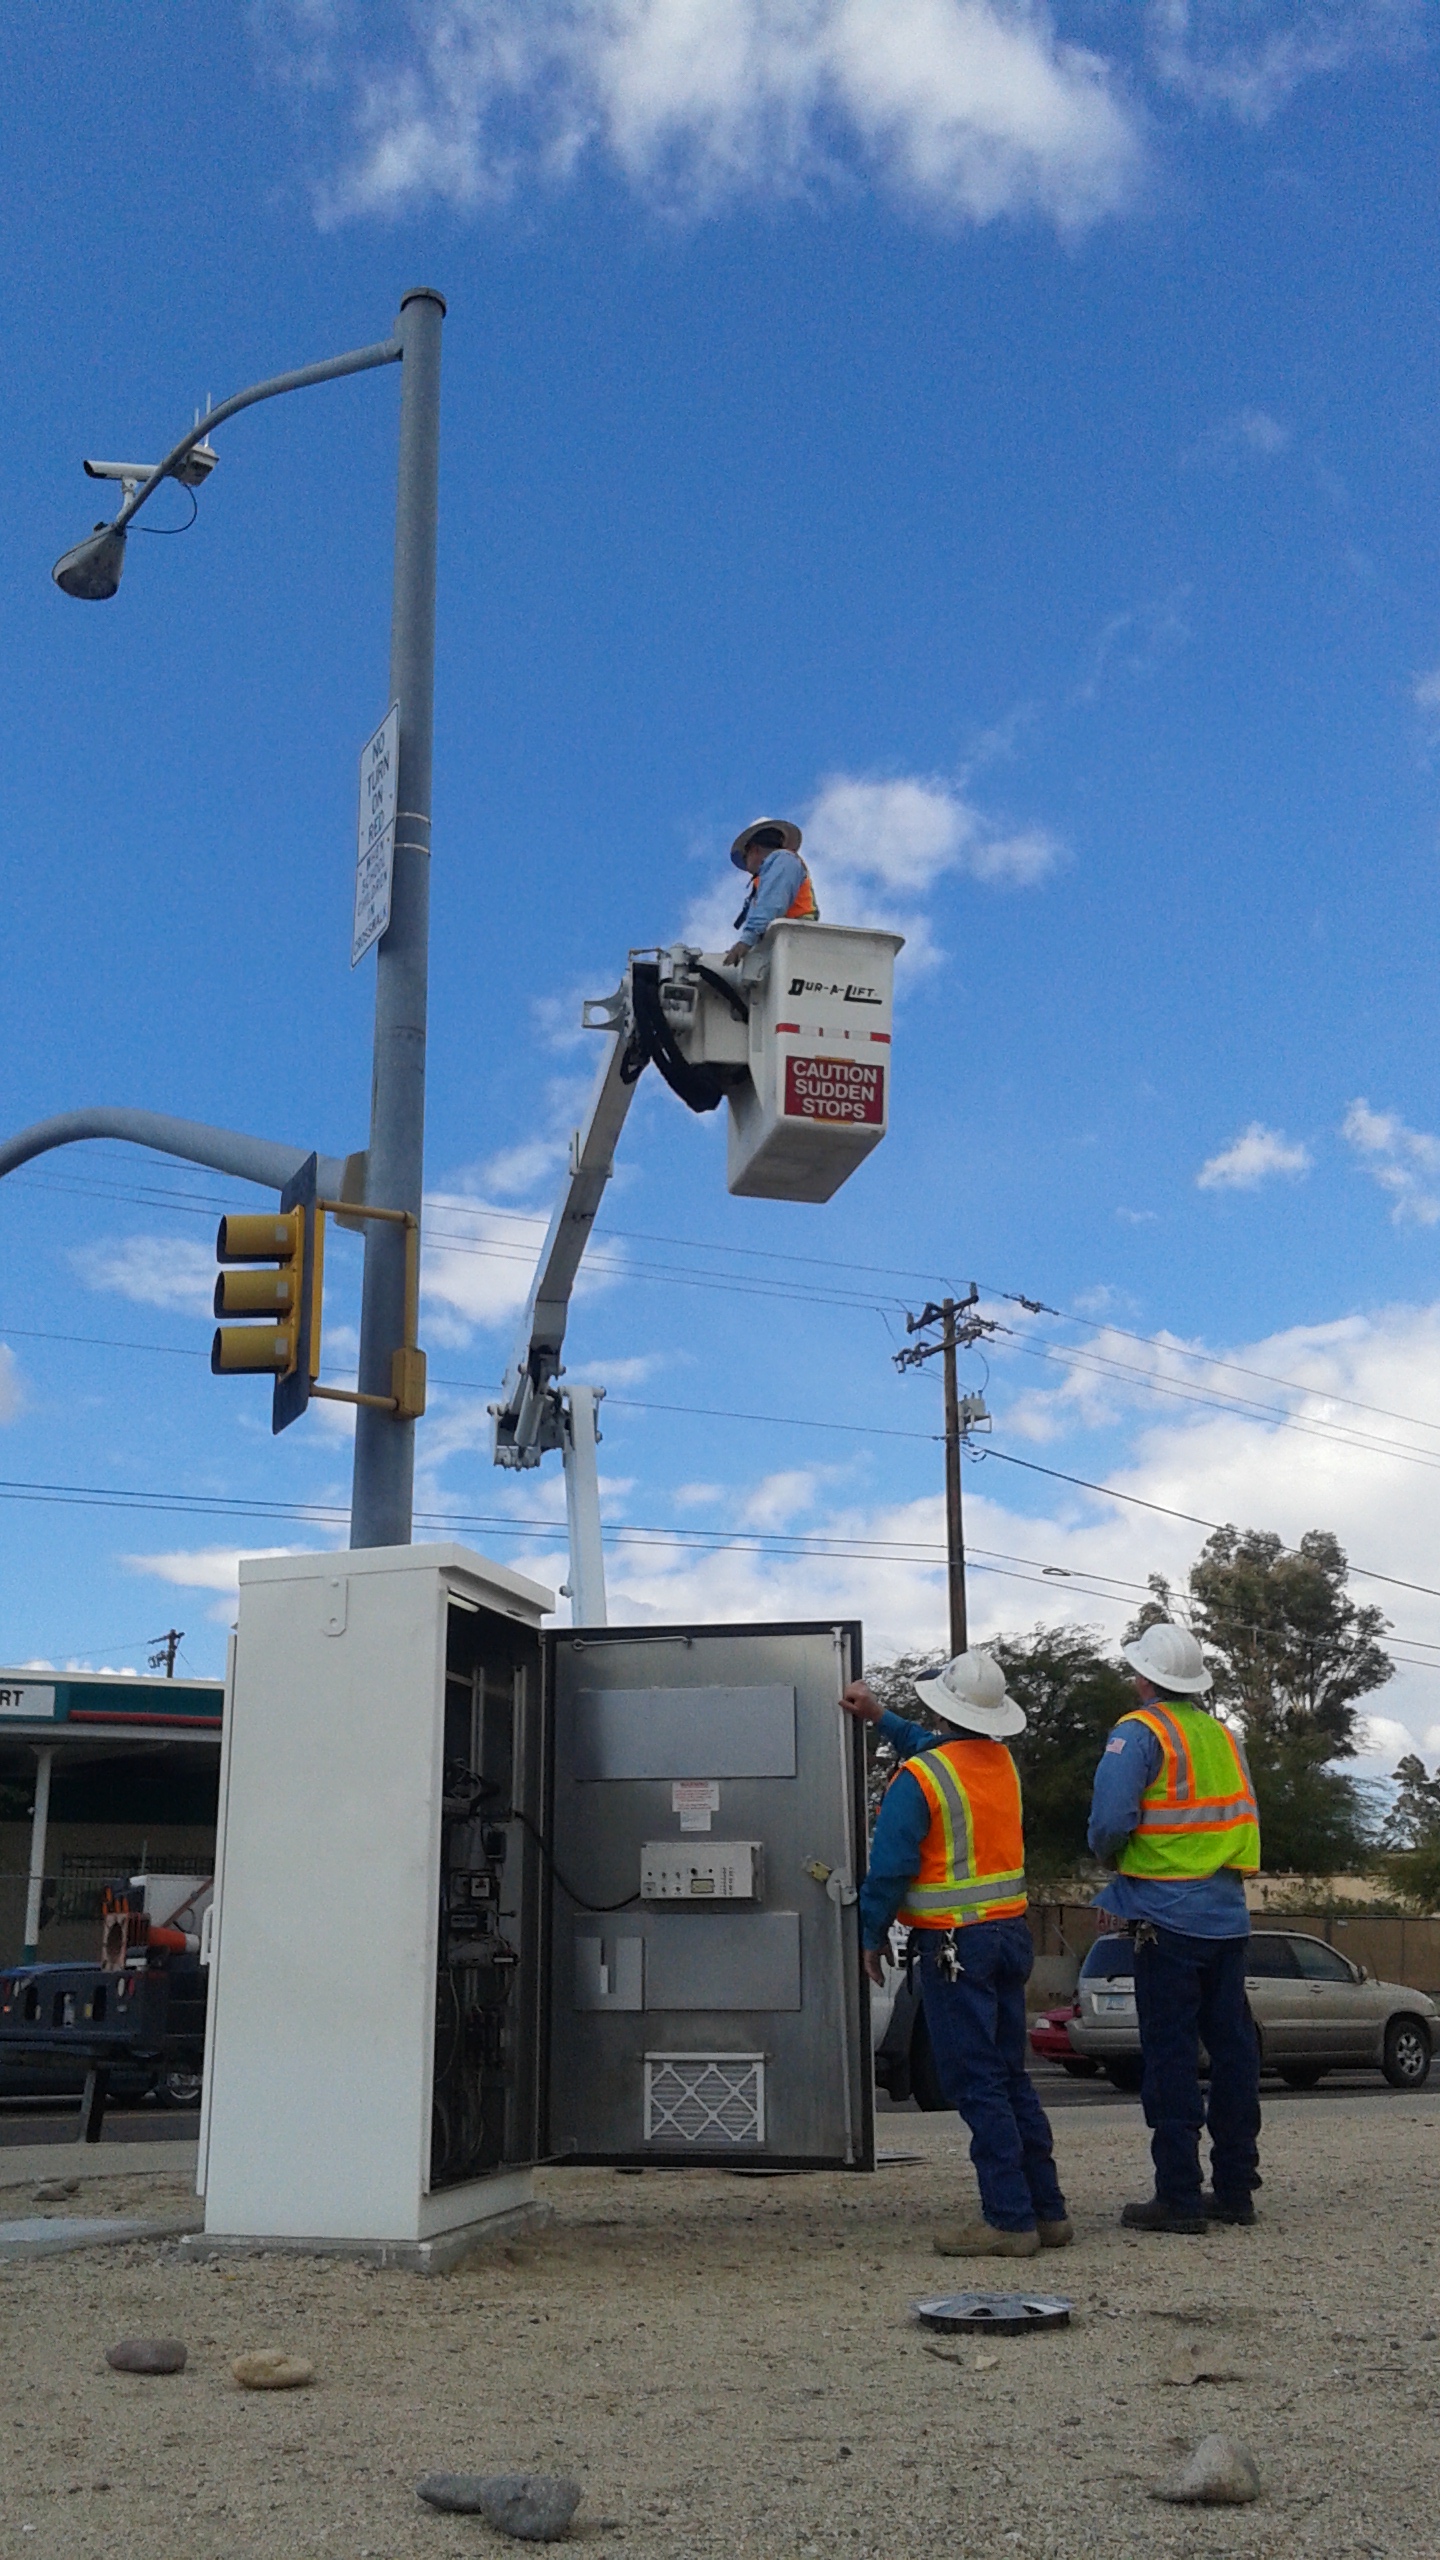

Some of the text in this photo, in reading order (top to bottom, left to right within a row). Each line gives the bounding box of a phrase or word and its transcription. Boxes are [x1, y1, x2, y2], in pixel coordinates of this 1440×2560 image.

[372, 732, 384, 763] NO
[367, 750, 389, 797] TURN
[372, 785, 383, 815] ON
[368, 809, 384, 845] RED
[793, 1060, 877, 1084] CAUTION
[795, 1078, 875, 1102] SUDDEN
[802, 1098, 866, 1119] STOPS
